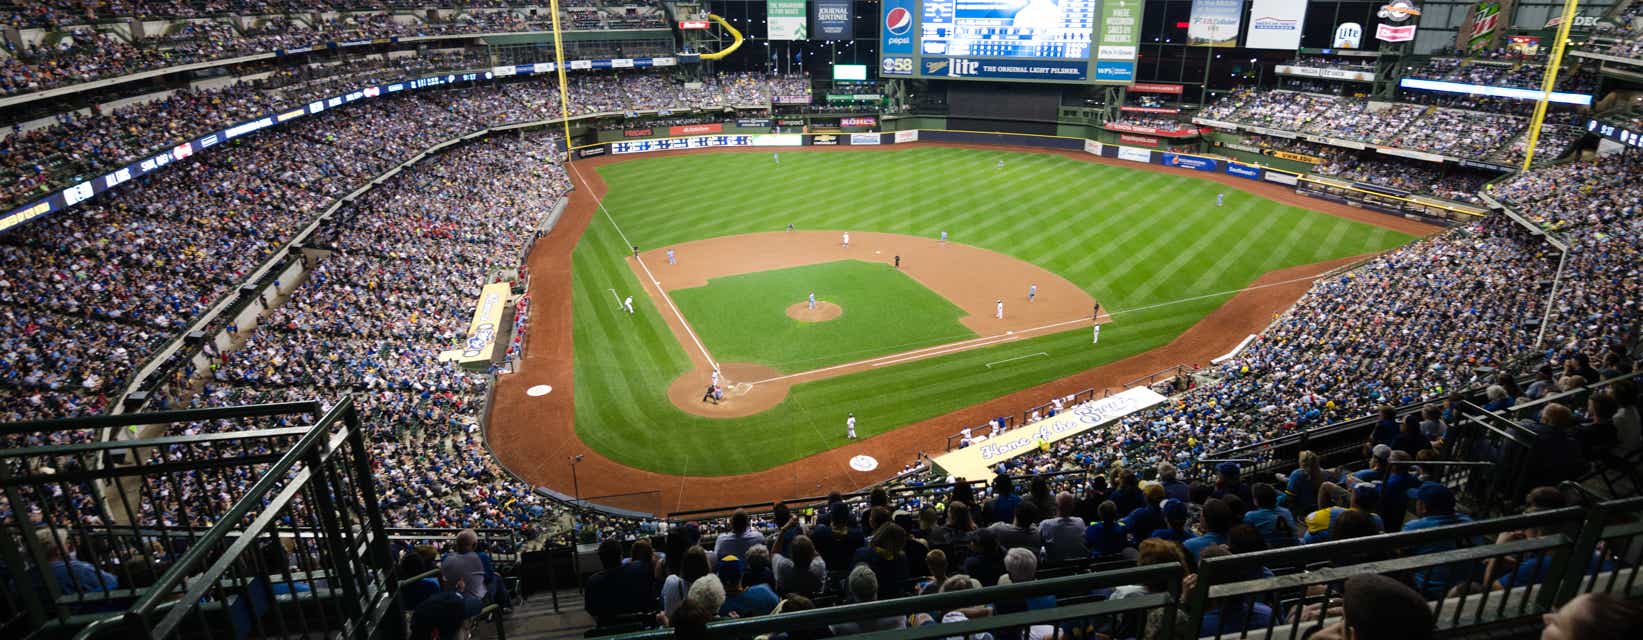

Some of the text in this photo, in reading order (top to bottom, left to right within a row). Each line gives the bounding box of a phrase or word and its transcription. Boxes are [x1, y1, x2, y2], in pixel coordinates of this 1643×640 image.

[1339, 27, 1359, 40] Lite
[888, 37, 910, 46] pepsi
[894, 58, 913, 71] 58
[981, 437, 1031, 460] Home
[1032, 424, 1053, 443] of
[1053, 420, 1077, 433] the
